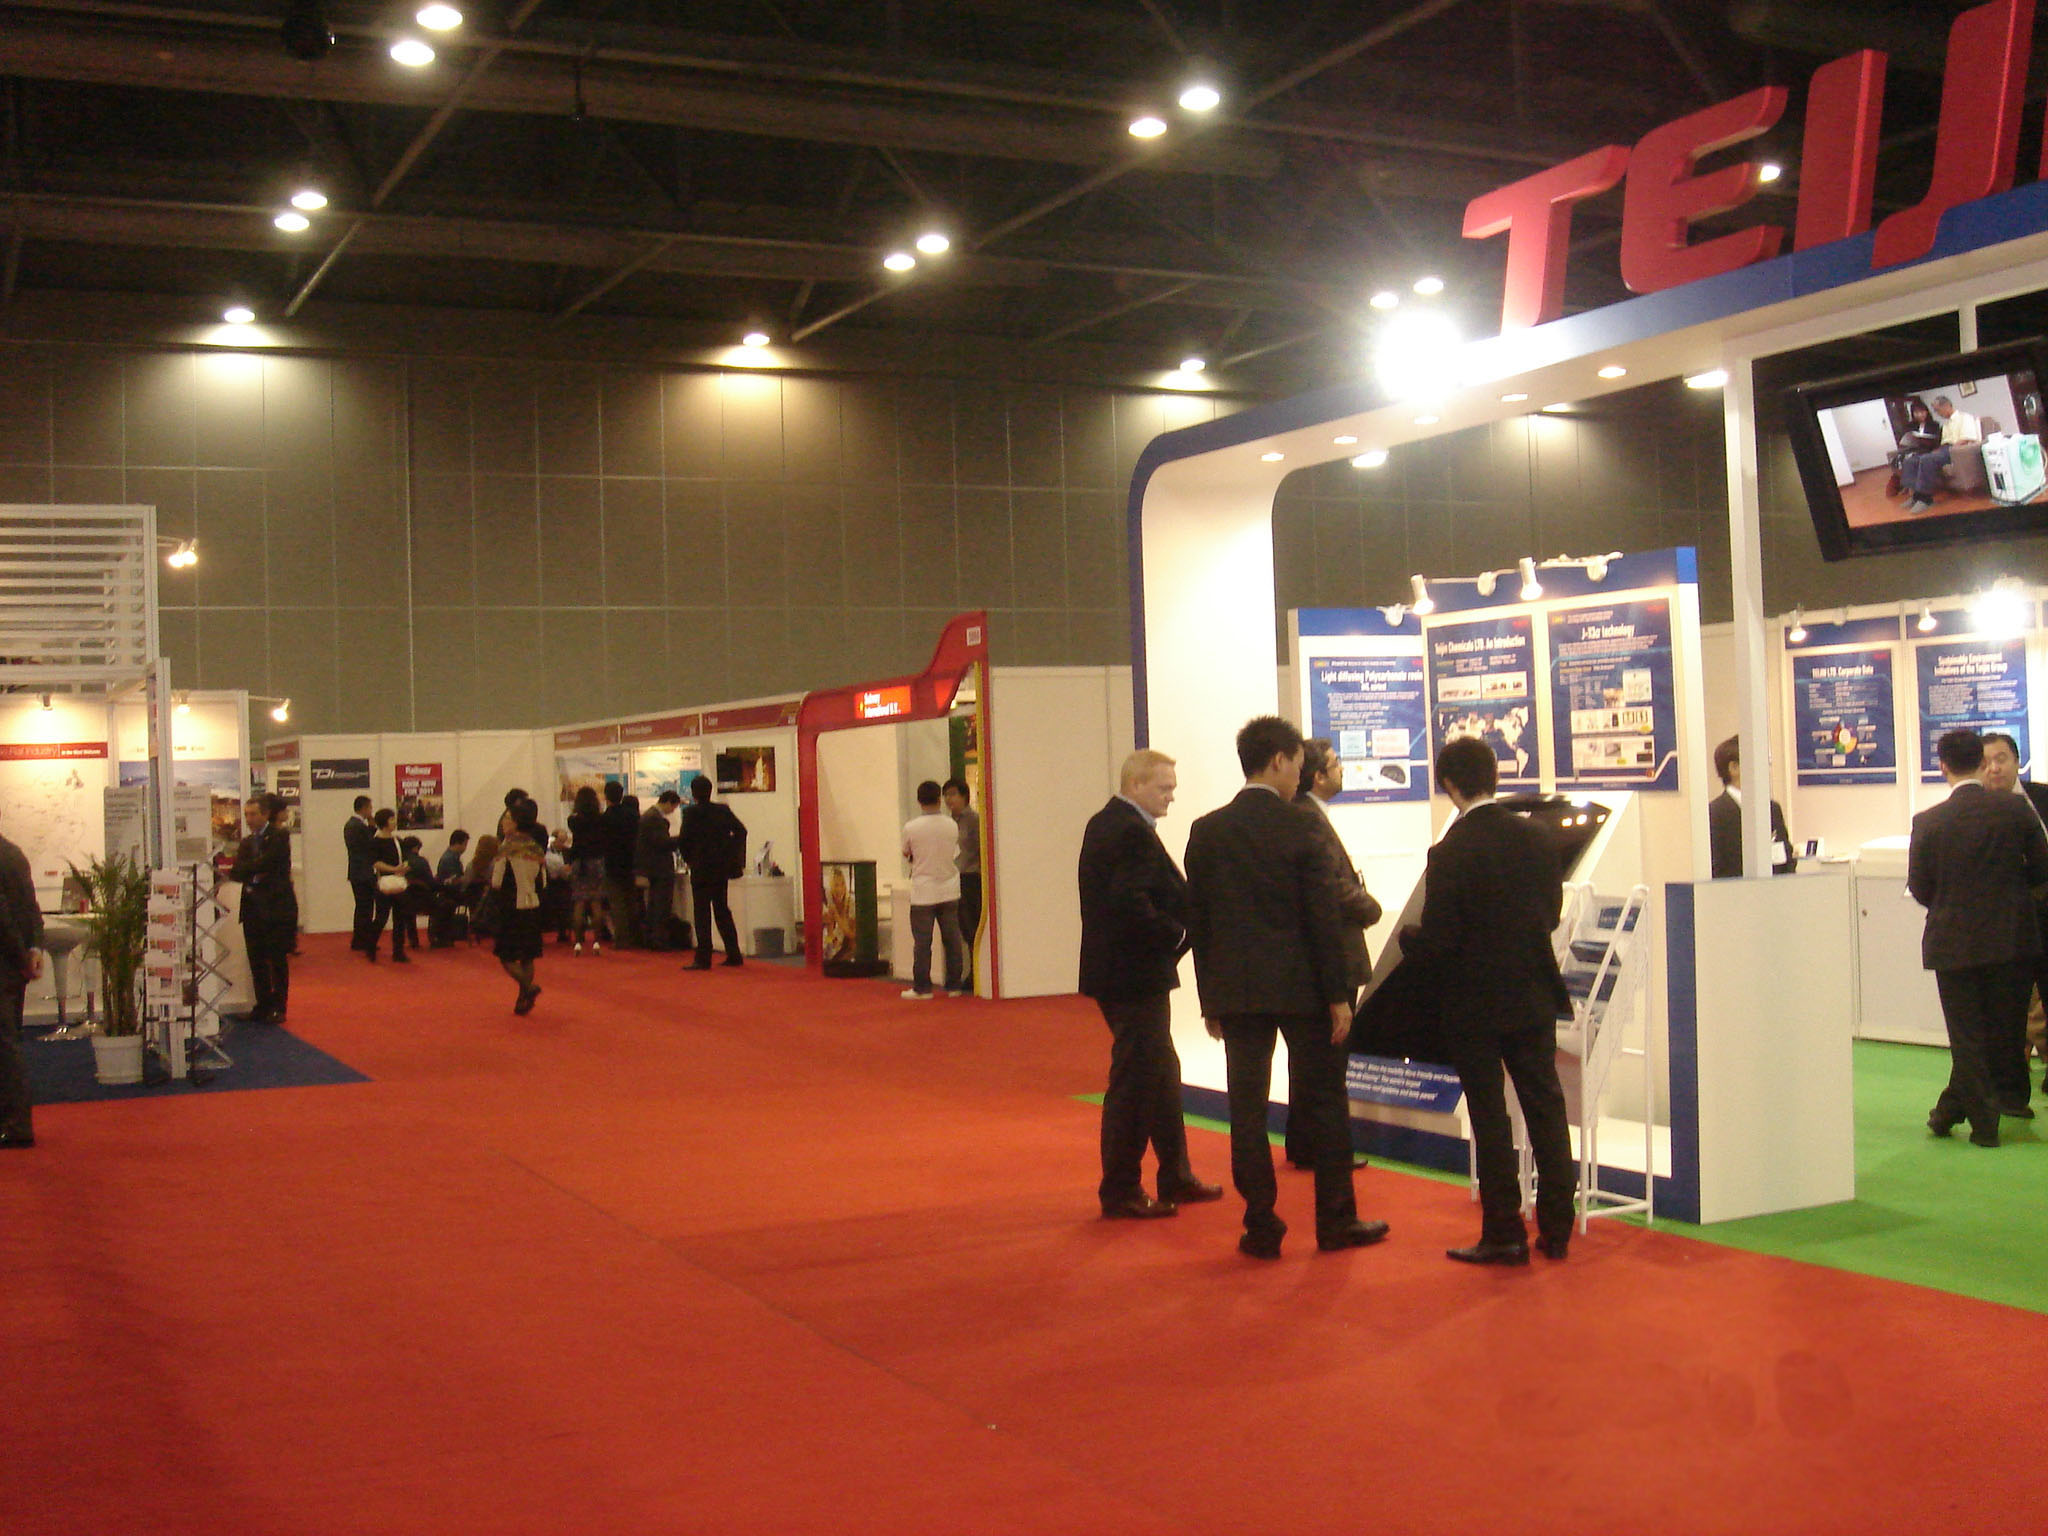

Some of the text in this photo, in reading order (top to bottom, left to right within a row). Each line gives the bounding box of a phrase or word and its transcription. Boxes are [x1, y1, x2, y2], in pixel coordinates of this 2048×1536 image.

[1462, 0, 2048, 327] TEIJ
[1321, 670, 1336, 685] Light
[1364, 670, 1407, 683] Polycarbonate
